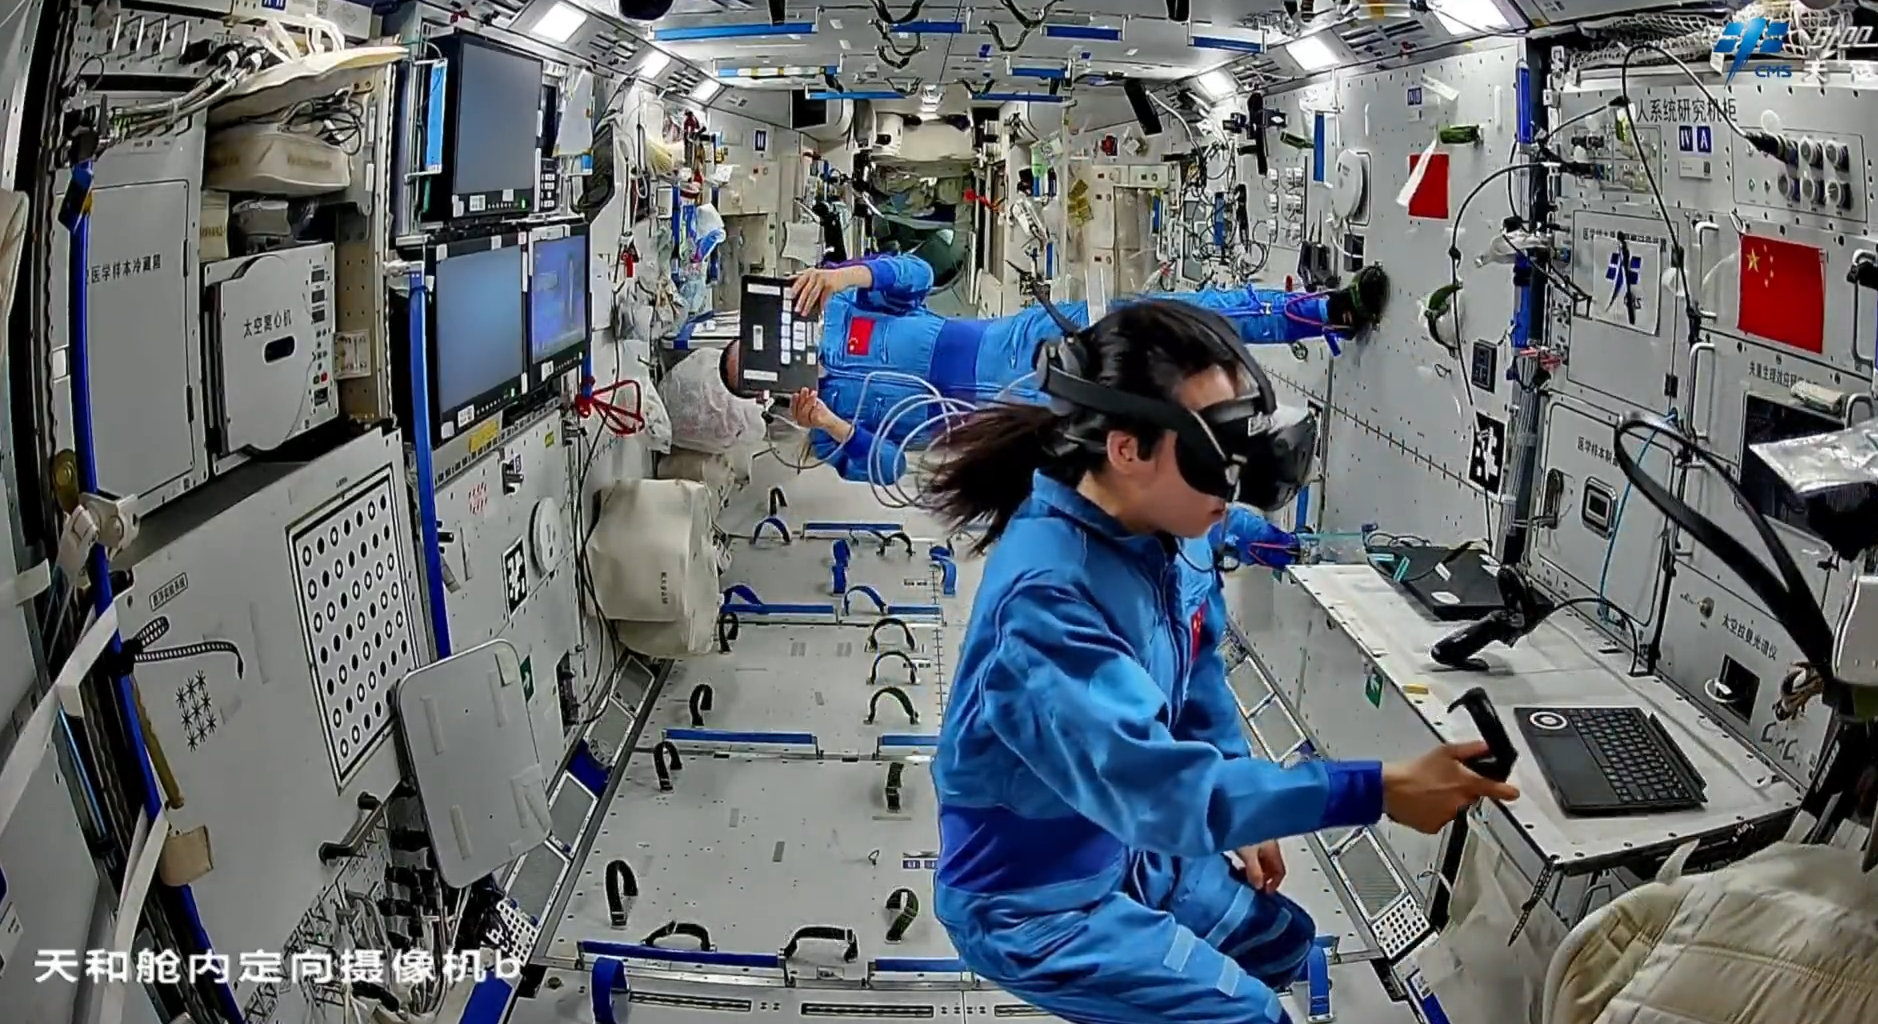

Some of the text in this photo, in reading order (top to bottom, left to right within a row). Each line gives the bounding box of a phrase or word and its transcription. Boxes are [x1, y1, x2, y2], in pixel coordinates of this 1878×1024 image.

[88, 253, 161, 284] 医学样本冷藏箱
[243, 308, 292, 339] 太空离心机
